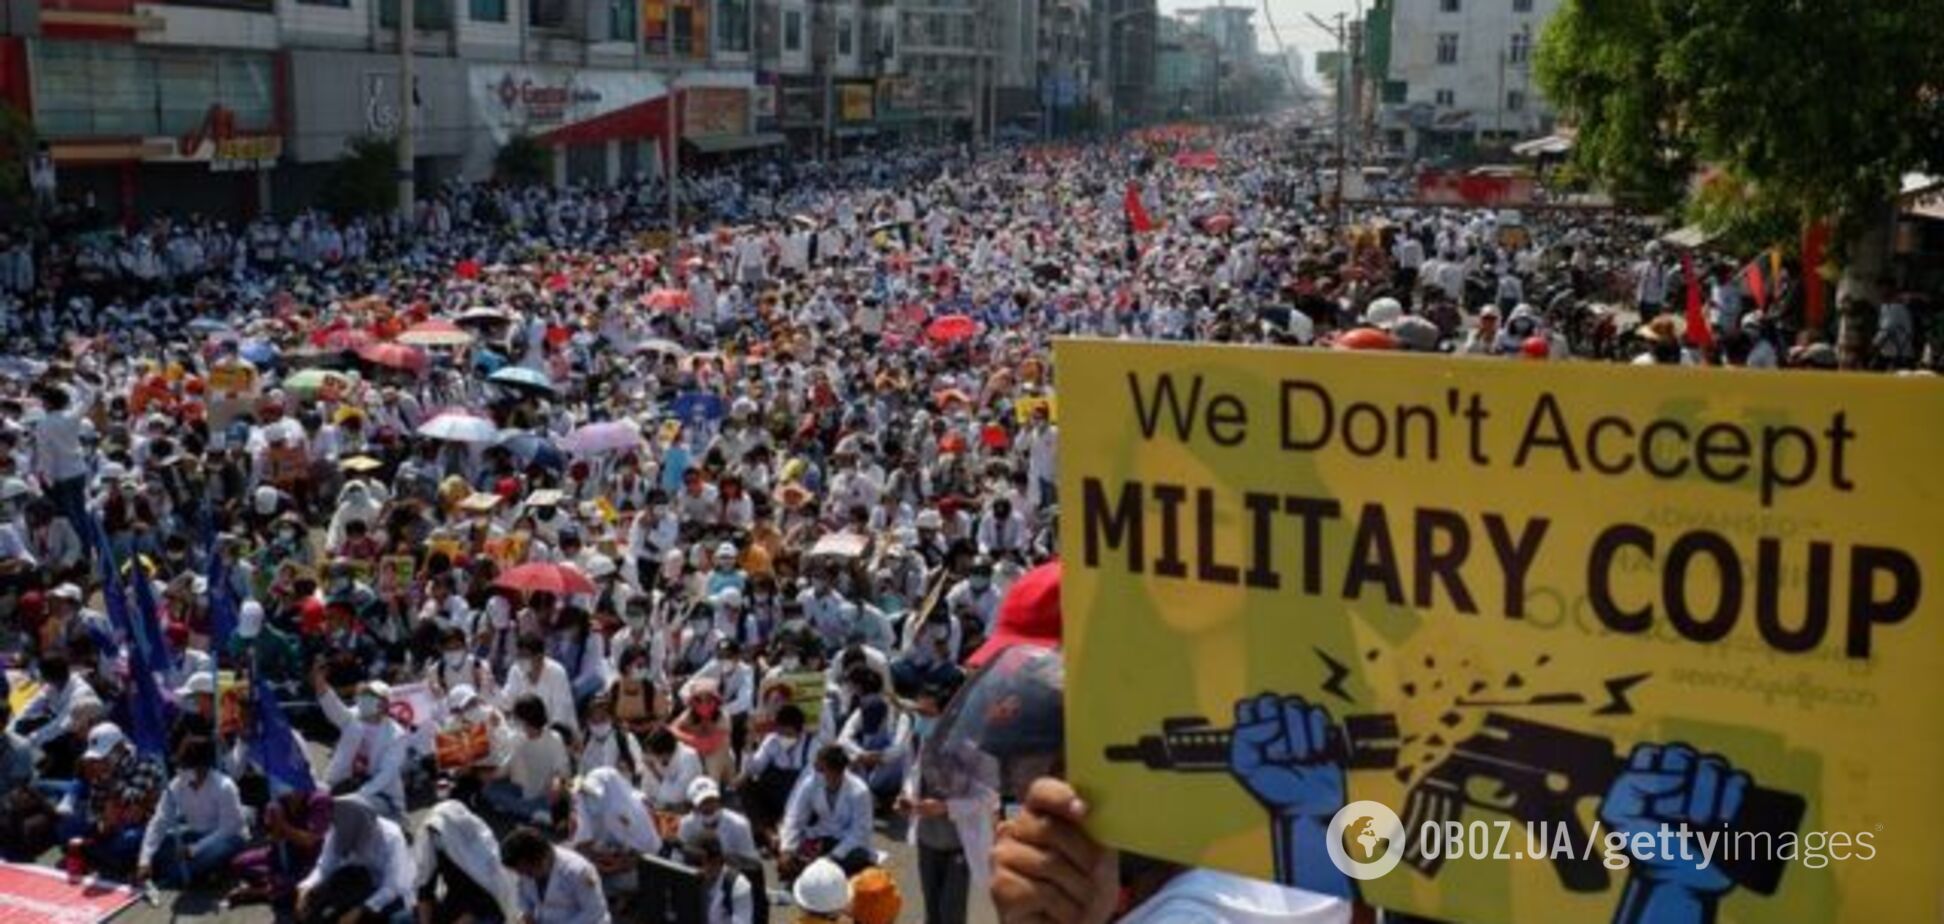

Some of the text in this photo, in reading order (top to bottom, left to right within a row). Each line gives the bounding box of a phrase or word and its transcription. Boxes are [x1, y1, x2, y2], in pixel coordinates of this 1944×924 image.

[1128, 373, 1855, 507] We Don't Accept
[1083, 478, 1549, 619] MILITARY
[1587, 523, 1922, 661] COUP
